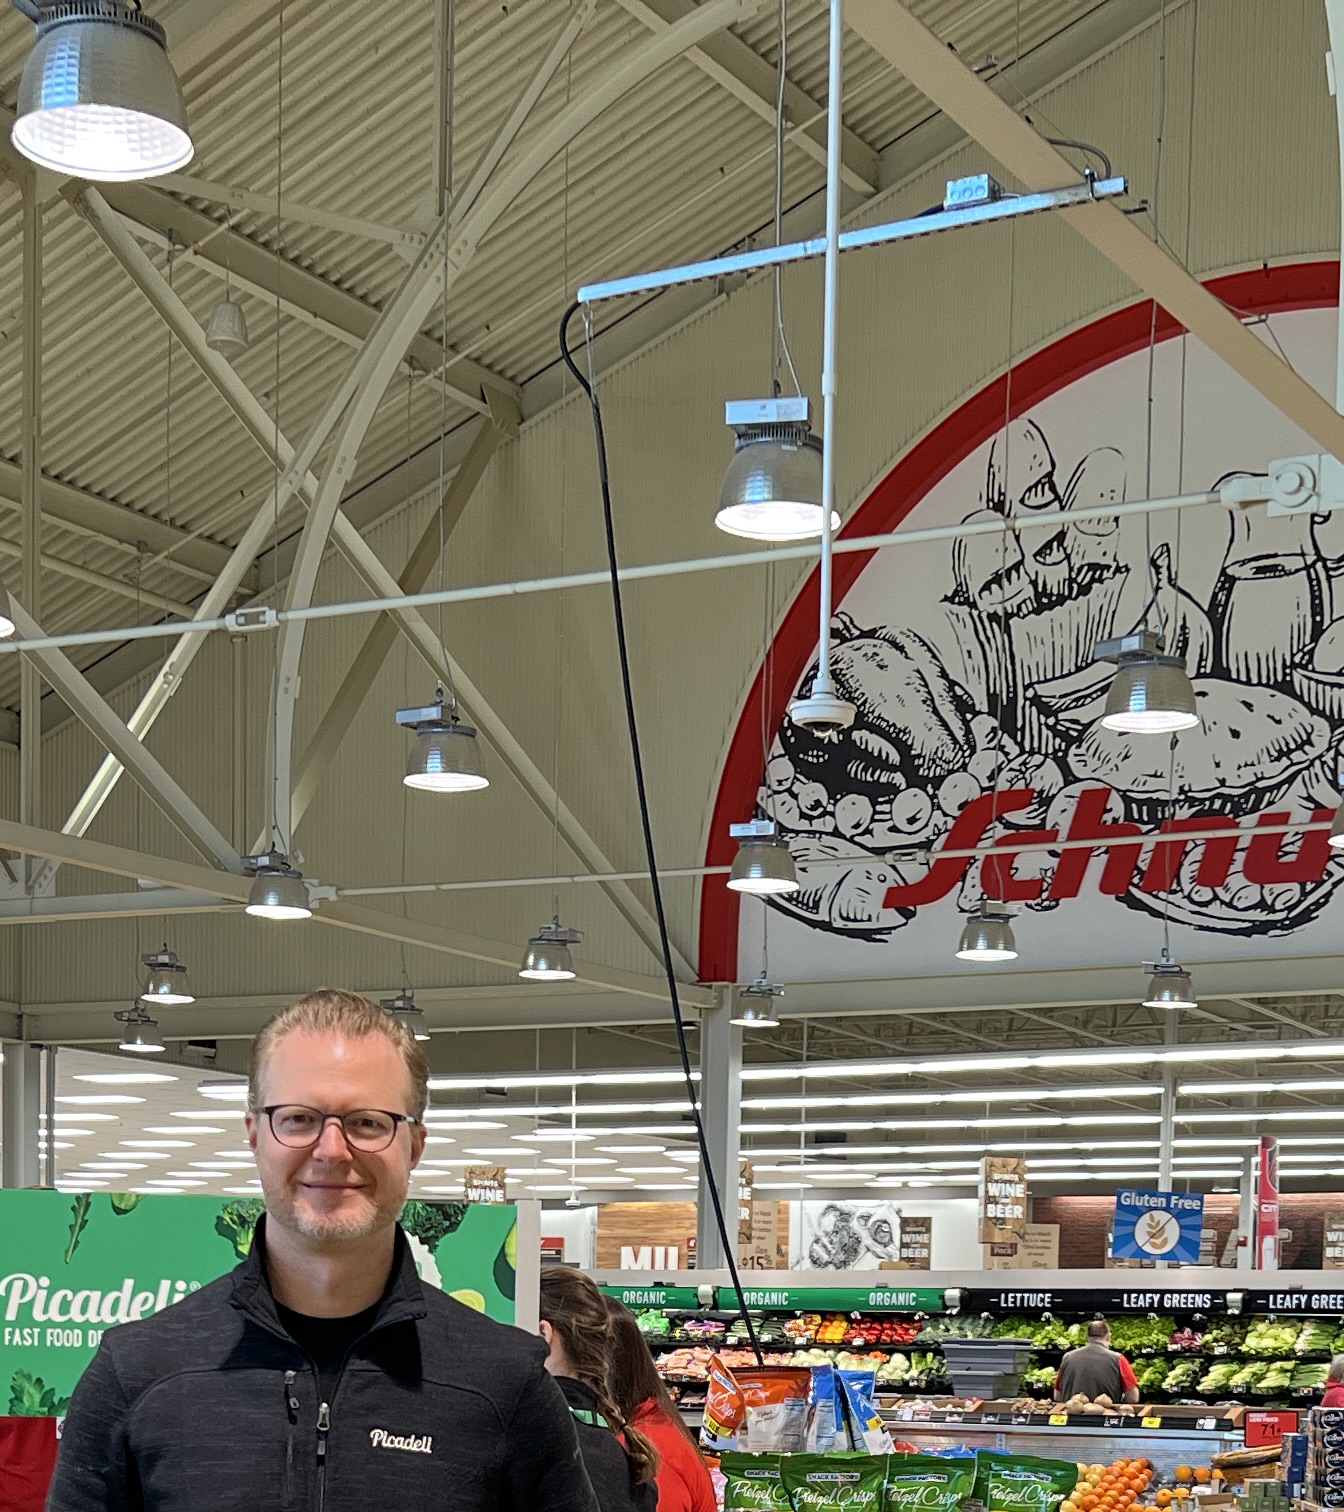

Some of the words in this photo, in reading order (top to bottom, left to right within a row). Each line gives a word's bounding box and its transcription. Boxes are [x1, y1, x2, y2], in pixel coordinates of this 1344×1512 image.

[467, 1188, 505, 1201] WINE
[987, 1183, 1025, 1198] WINE
[1120, 1191, 1167, 1209] Gluten
[1170, 1195, 1201, 1210] Free
[986, 1204, 1025, 1219] BEER
[622, 1290, 666, 1305] ORGANIC
[743, 1291, 789, 1306] ORGANIC
[868, 1291, 917, 1306] ORGANIC
[1000, 1292, 1052, 1307] LETTUCE
[1122, 1293, 1160, 1308] LEAFY
[1163, 1294, 1212, 1308] GREENS
[1268, 1294, 1309, 1308] LEAFY
[4, 1327, 41, 1347] FAST
[46, 1328, 83, 1348] FOOD
[369, 1428, 433, 1454] Picadeli
